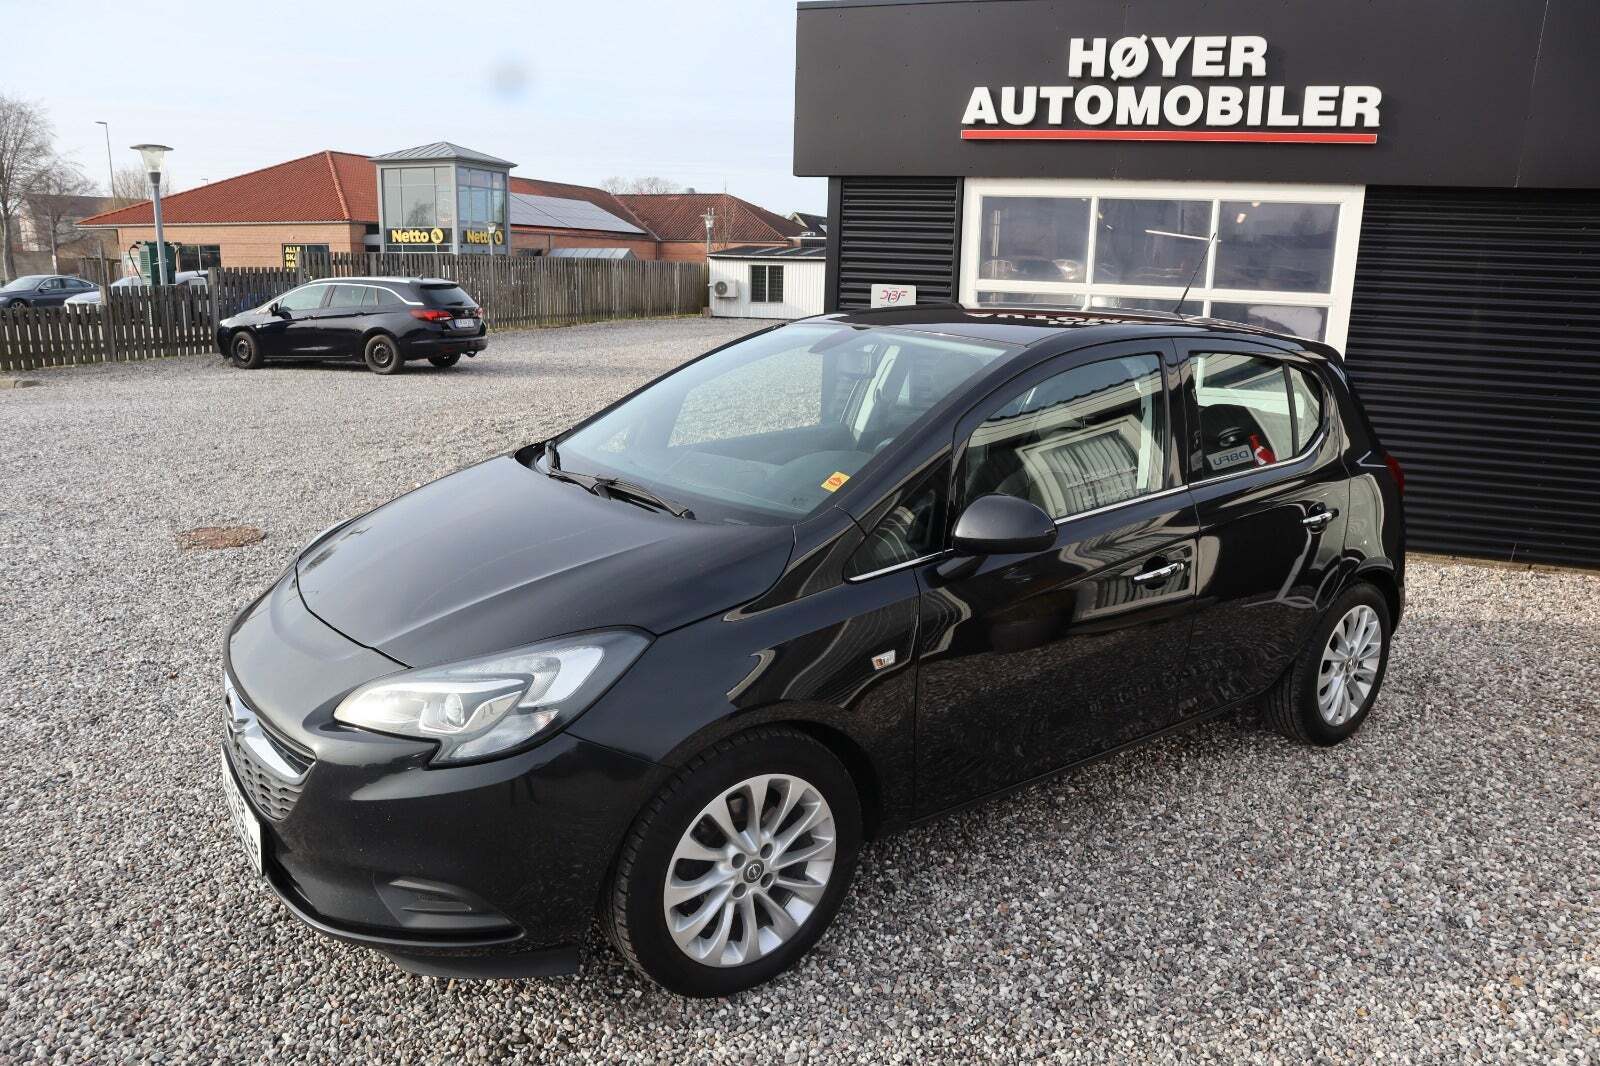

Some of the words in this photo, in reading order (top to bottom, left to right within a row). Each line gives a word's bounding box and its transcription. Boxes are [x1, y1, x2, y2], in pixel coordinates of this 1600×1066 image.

[1068, 34, 1268, 80] HØYER
[961, 85, 1382, 127] AUTOMOBILER
[391, 229, 430, 244] Netto
